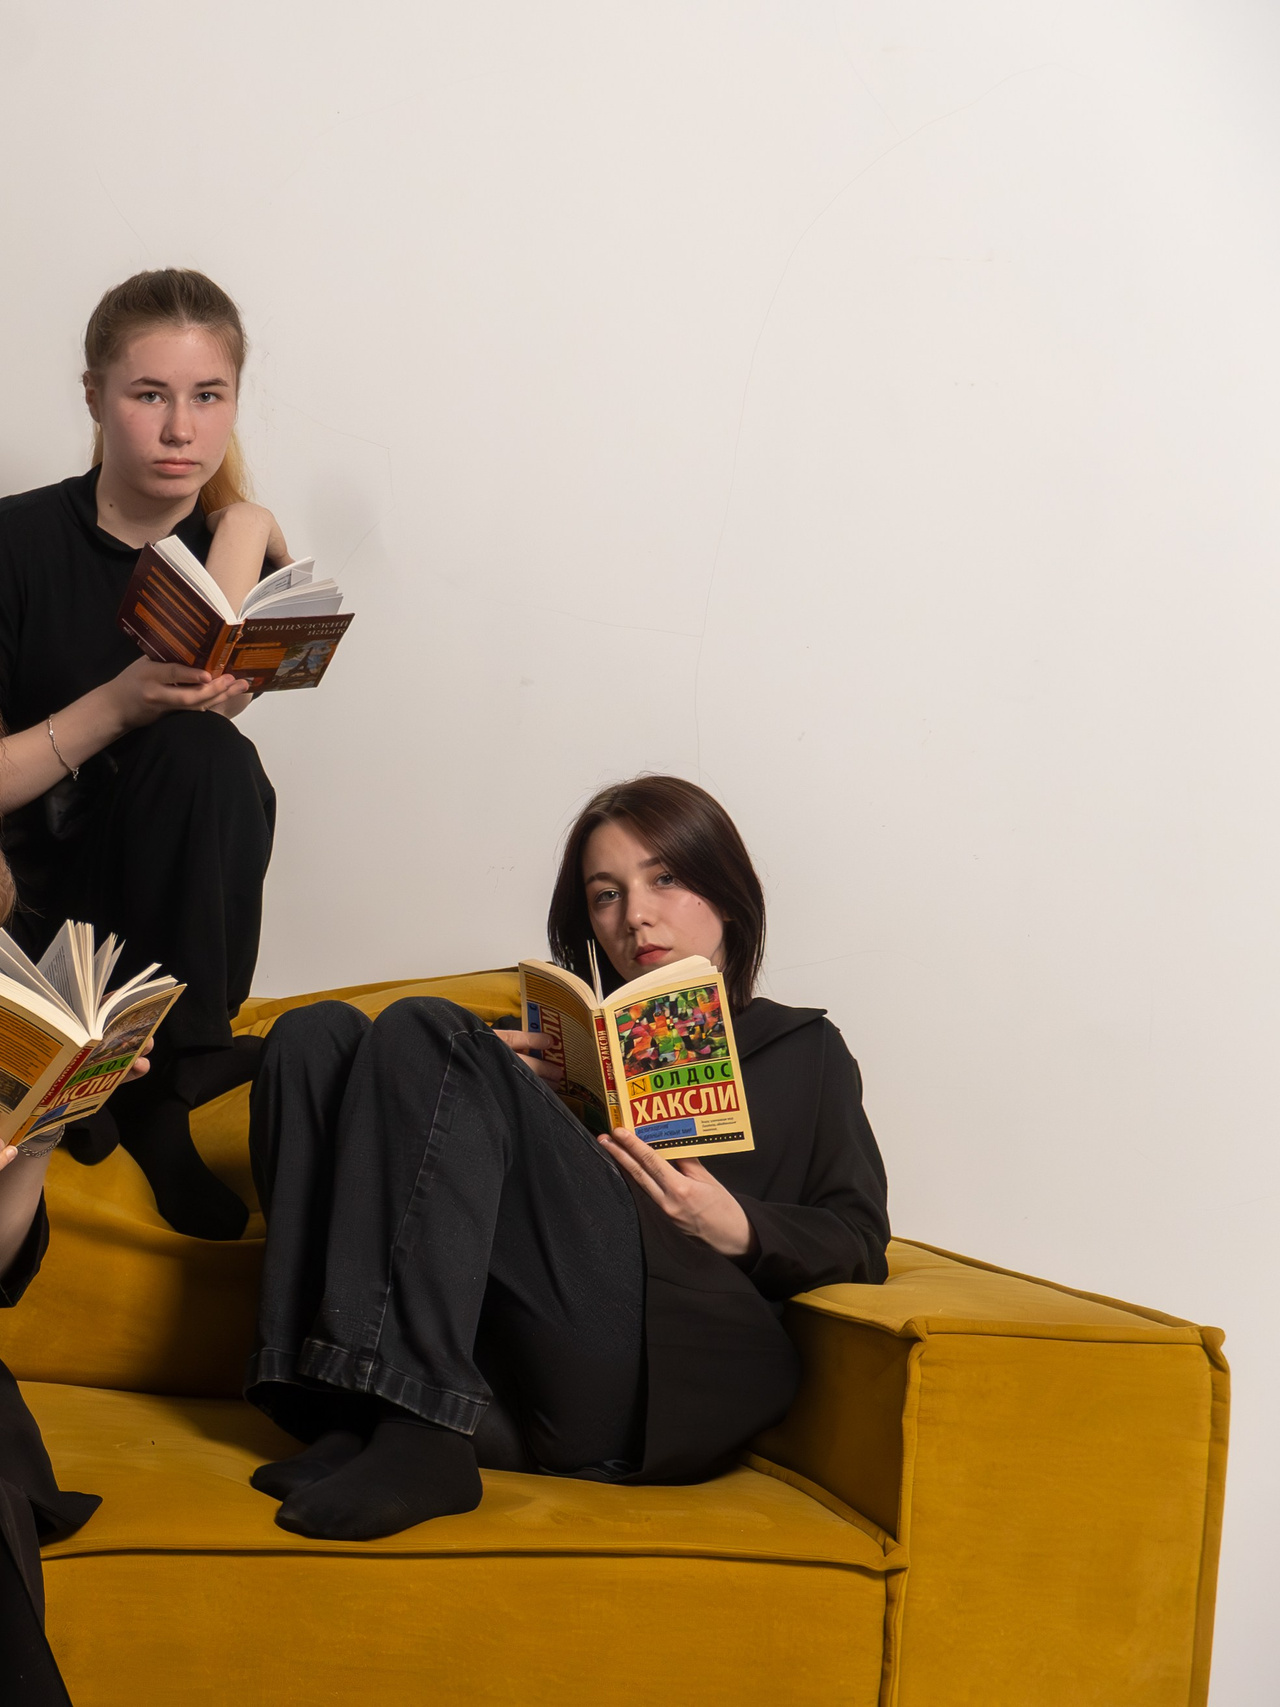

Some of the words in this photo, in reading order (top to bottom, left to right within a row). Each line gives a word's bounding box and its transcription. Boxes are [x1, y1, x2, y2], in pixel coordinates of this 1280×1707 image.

[247, 620, 349, 632] ФРАНЦУЗСКИЙ
[598, 1030, 611, 1061] ХАКСЛИ
[652, 1062, 731, 1089] ОЛДОС
[632, 1084, 738, 1125] ХАКСЛИ
